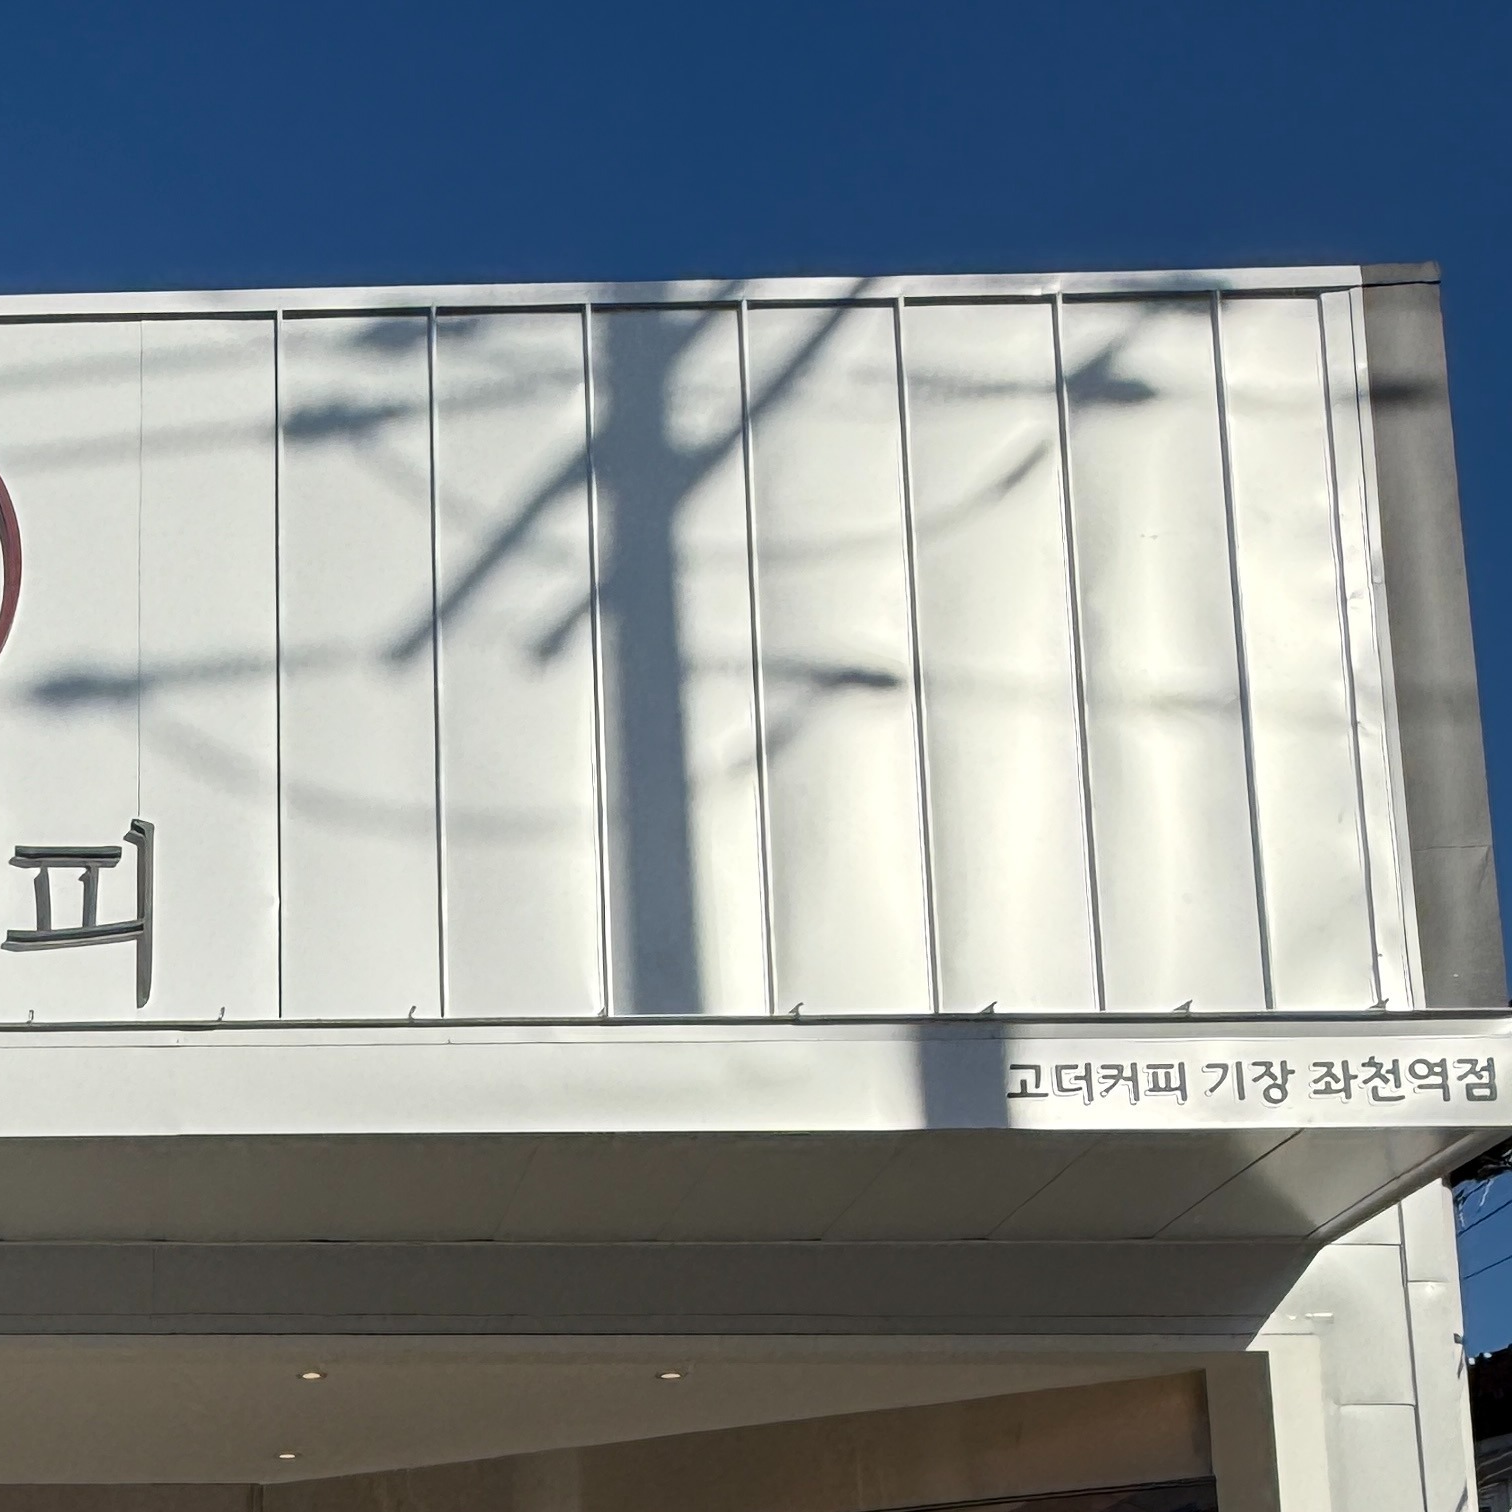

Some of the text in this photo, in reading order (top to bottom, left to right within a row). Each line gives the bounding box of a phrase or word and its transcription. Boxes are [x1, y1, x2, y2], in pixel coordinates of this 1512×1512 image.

[1006, 1055, 1499, 1105] 고더커피 기장 좌천역점
